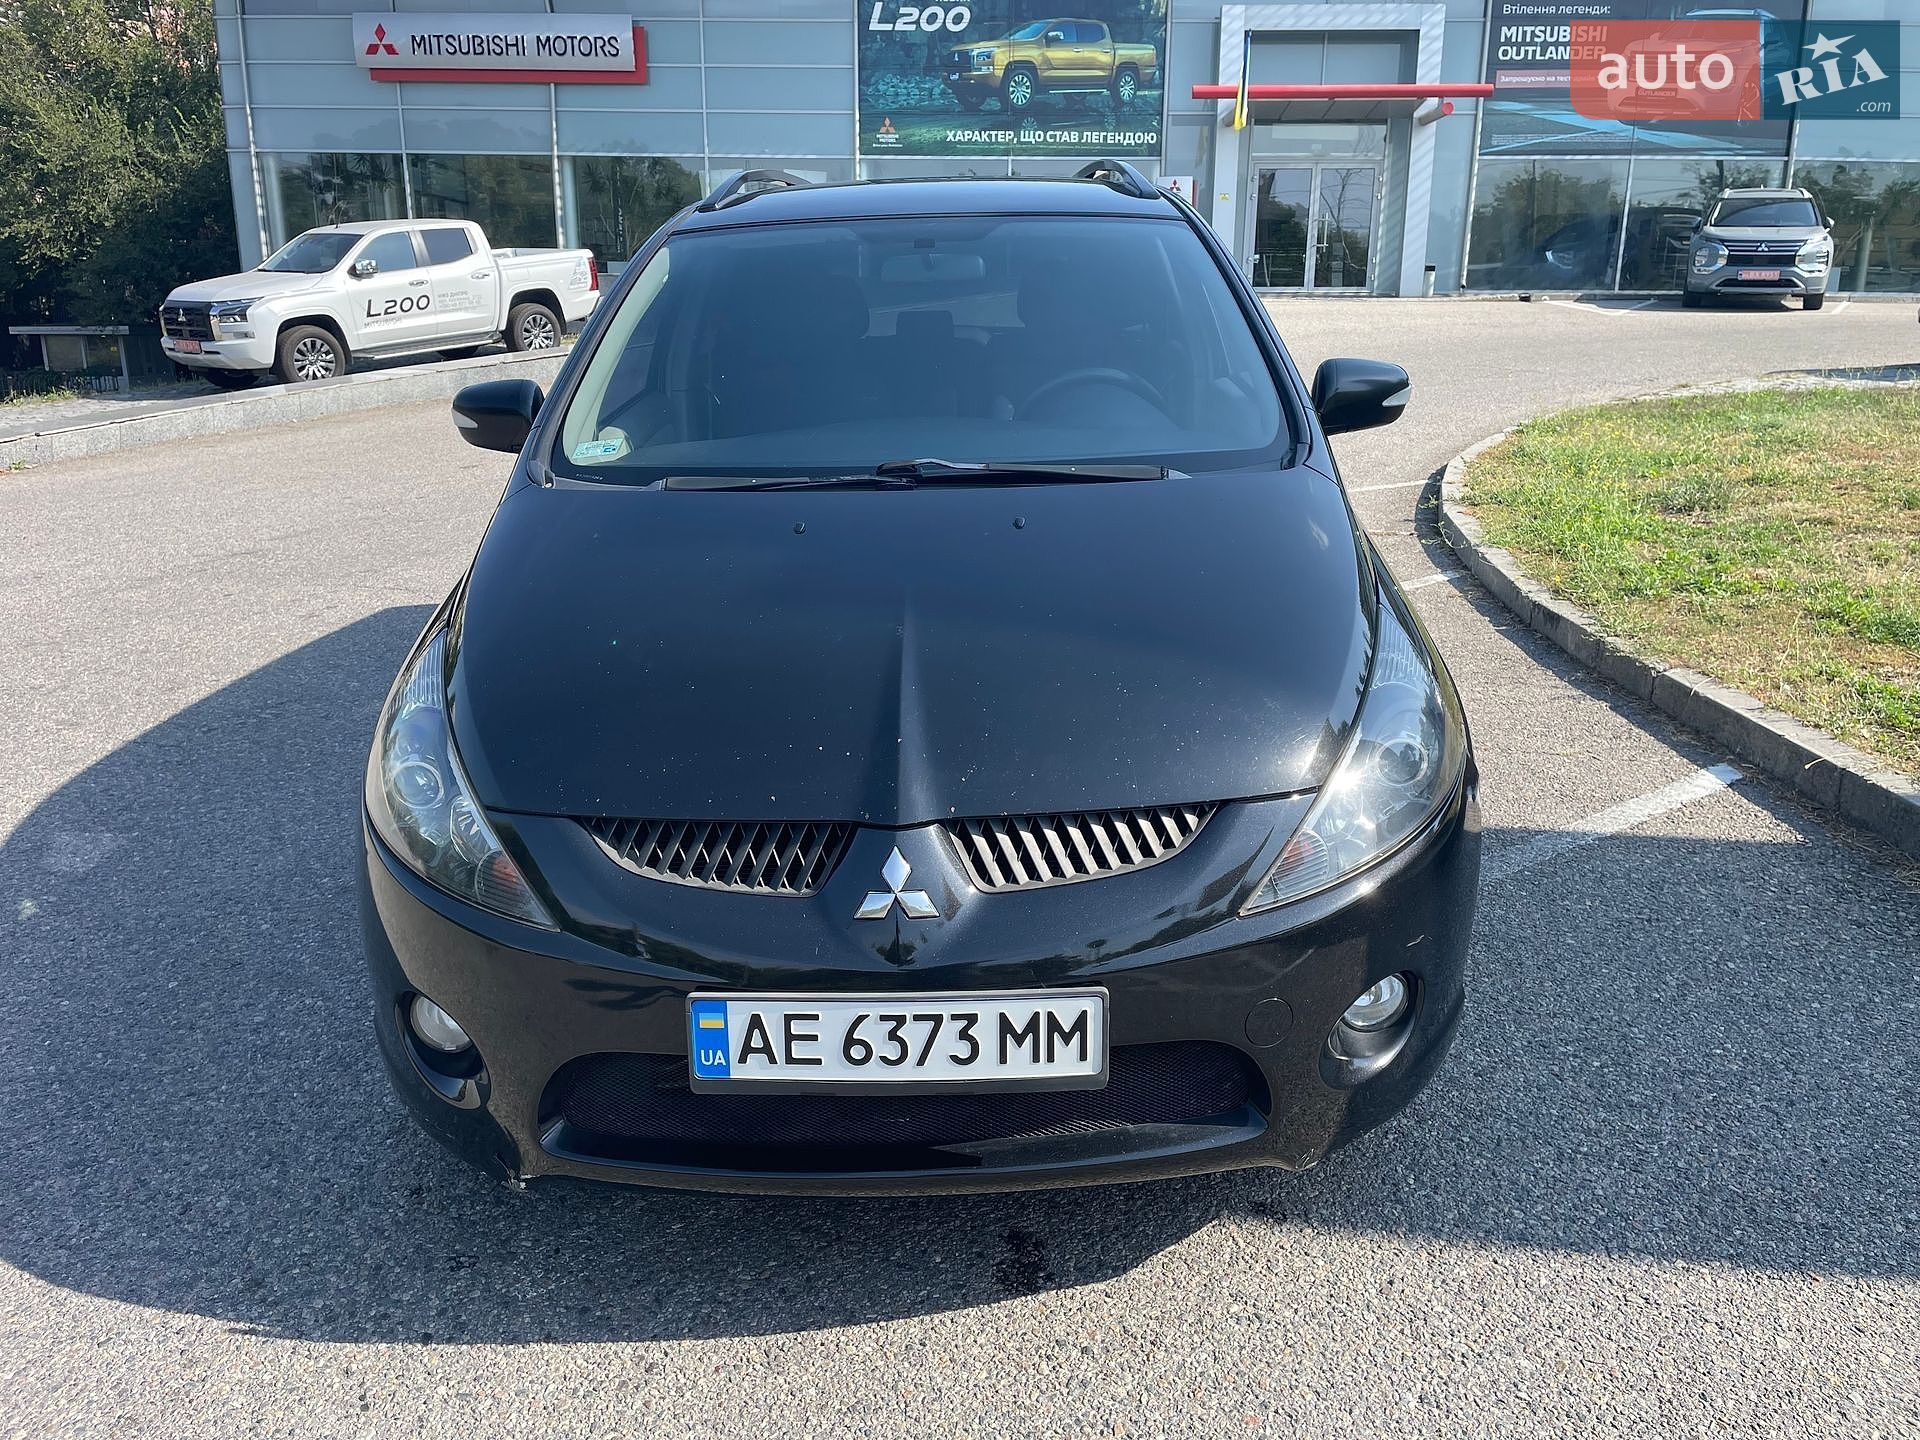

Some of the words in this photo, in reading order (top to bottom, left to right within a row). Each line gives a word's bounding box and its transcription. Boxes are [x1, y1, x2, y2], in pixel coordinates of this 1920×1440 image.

[868, 1, 972, 33] L200
[1503, 4, 1556, 14] Втілення
[1558, 5, 1611, 16] легенди:
[1500, 25, 1608, 43] MITSUBISHI
[411, 34, 527, 57] MITSUBISHI
[535, 35, 620, 58] MOTORS
[1498, 45, 1607, 61] OUTLANDER
[946, 130, 1017, 143] ХАРАКТЕР,
[1020, 131, 1044, 144] ЩО
[1047, 131, 1079, 143] СТАВ
[1081, 132, 1157, 146] ЛЕГЕНДОЮ
[366, 294, 430, 318] L200
[737, 1012, 822, 1066] AE
[843, 1012, 980, 1067] 6373
[998, 1009, 1089, 1065] MM
[701, 1050, 726, 1066] UA
